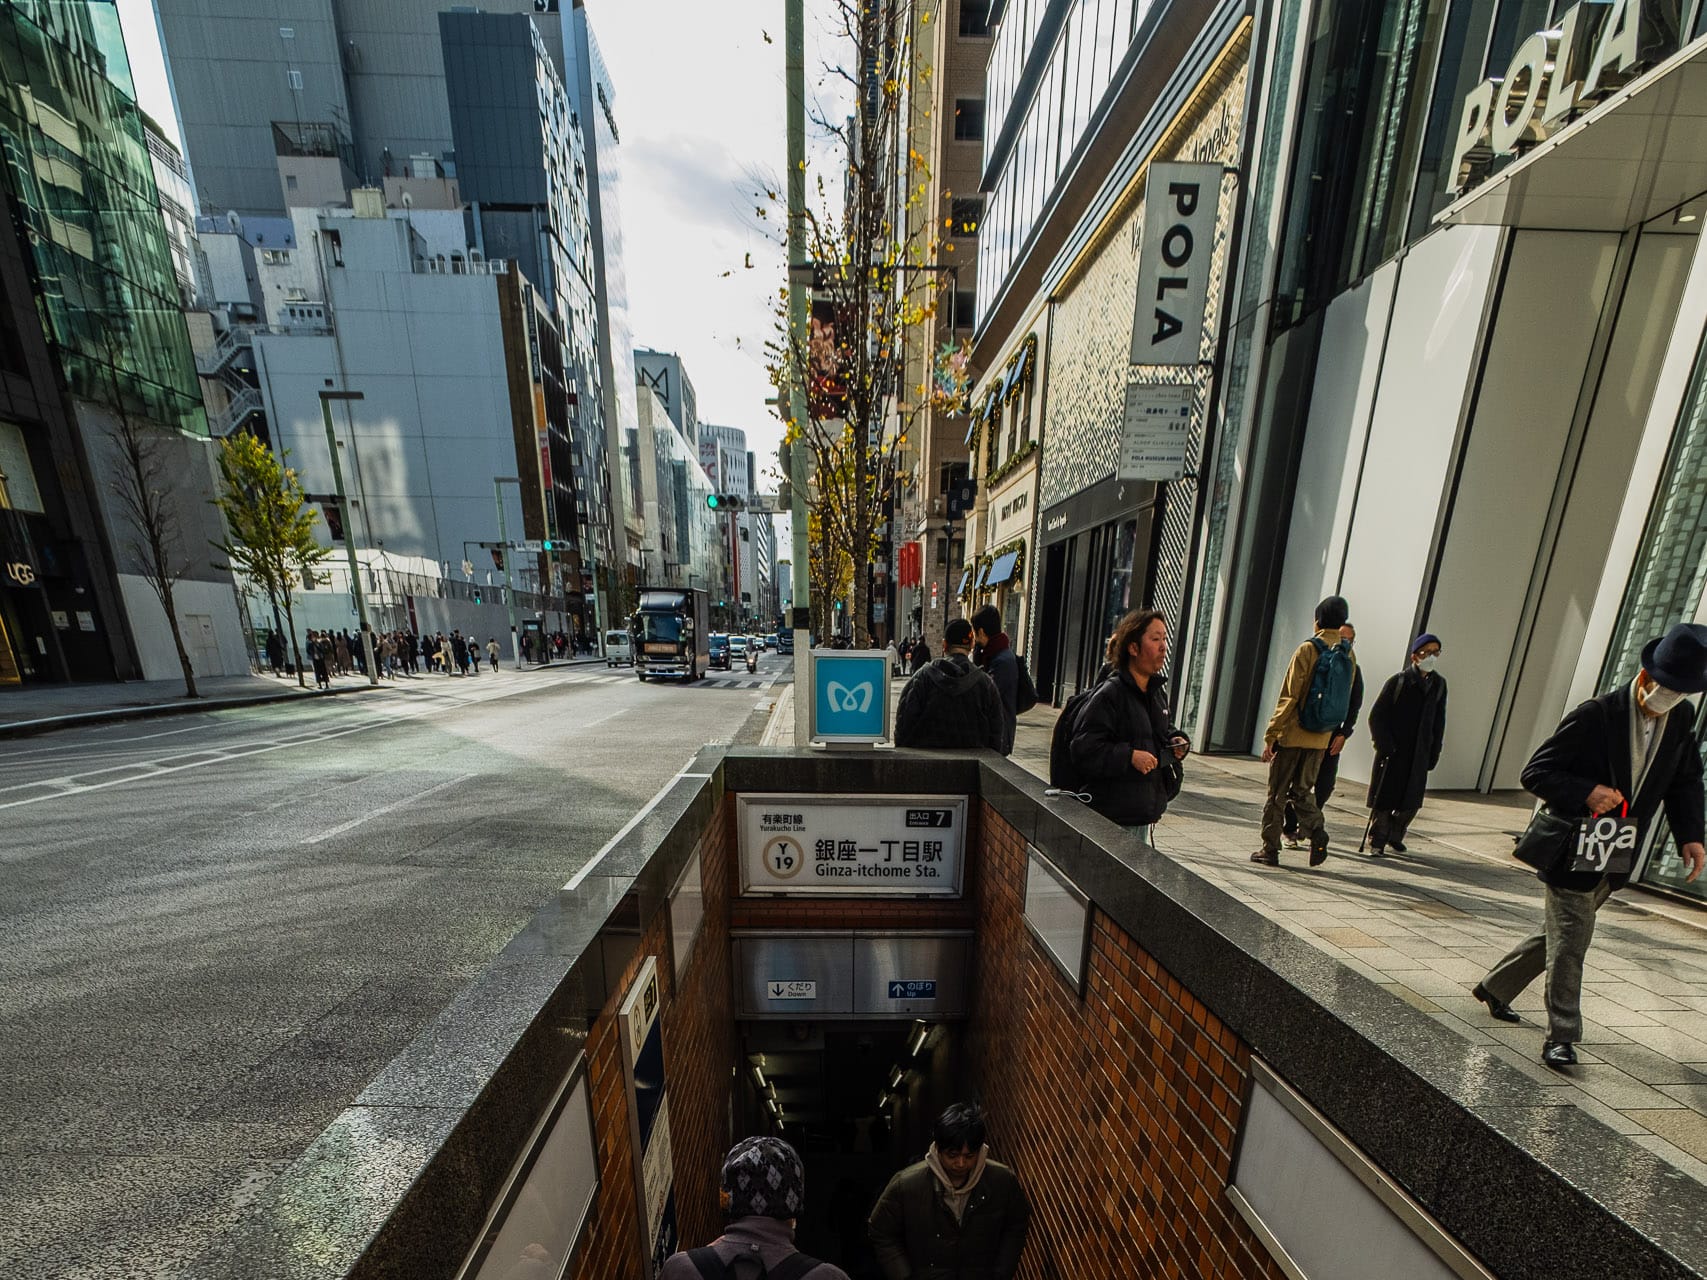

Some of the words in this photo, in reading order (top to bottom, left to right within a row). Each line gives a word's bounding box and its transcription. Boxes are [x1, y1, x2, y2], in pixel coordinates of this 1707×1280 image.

[1445, 0, 1641, 194] POLA
[1151, 182, 1201, 346] POLA
[6, 561, 35, 586] UGG
[761, 814, 803, 825] 有楽町線
[909, 812, 929, 820] 出入口
[936, 812, 945, 826] 7
[760, 825, 792, 833] Yurakucho
[778, 843, 789, 855] Y
[815, 840, 943, 863] 銀座一丁目駅
[775, 857, 794, 870] 19
[815, 864, 911, 878] Ginza-itchome
[915, 864, 941, 878] Sta.
[787, 982, 812, 991] くだり
